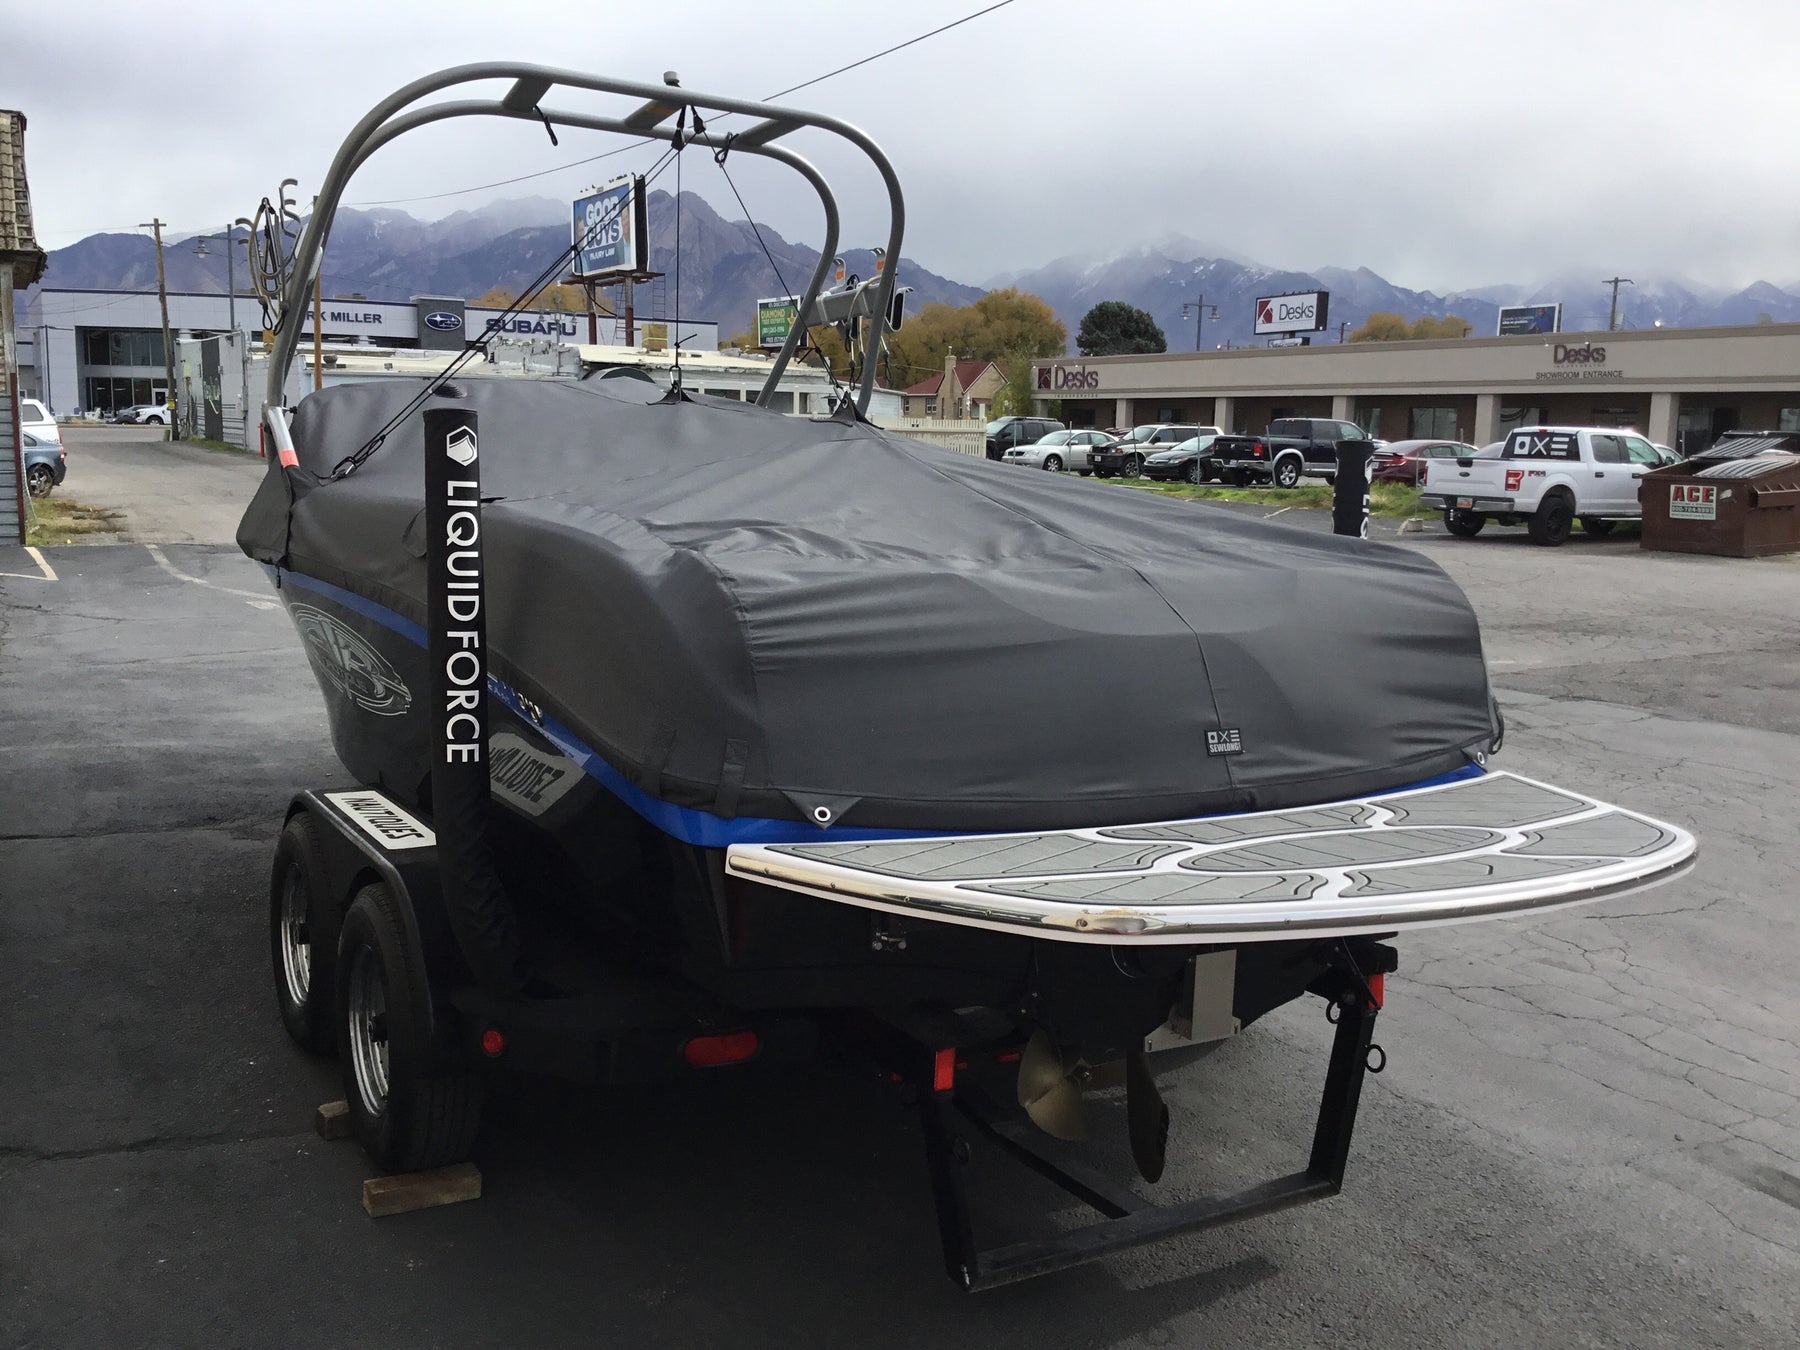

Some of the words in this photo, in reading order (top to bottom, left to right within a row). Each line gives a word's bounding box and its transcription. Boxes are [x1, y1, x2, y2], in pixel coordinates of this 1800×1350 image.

[586, 195, 620, 226] GOOD
[586, 219, 620, 249] GUYS
[331, 312, 382, 324] MILLER
[1279, 301, 1314, 320] Desks
[485, 318, 577, 336] SUBARU
[1553, 342, 1607, 365] Desks
[1054, 365, 1099, 390] Desks
[1535, 371, 1580, 380] SHOWROOM
[1583, 370, 1623, 379] ENTRANCE
[1672, 486, 1715, 503] ACE
[341, 797, 425, 840] NAUTIQUES
